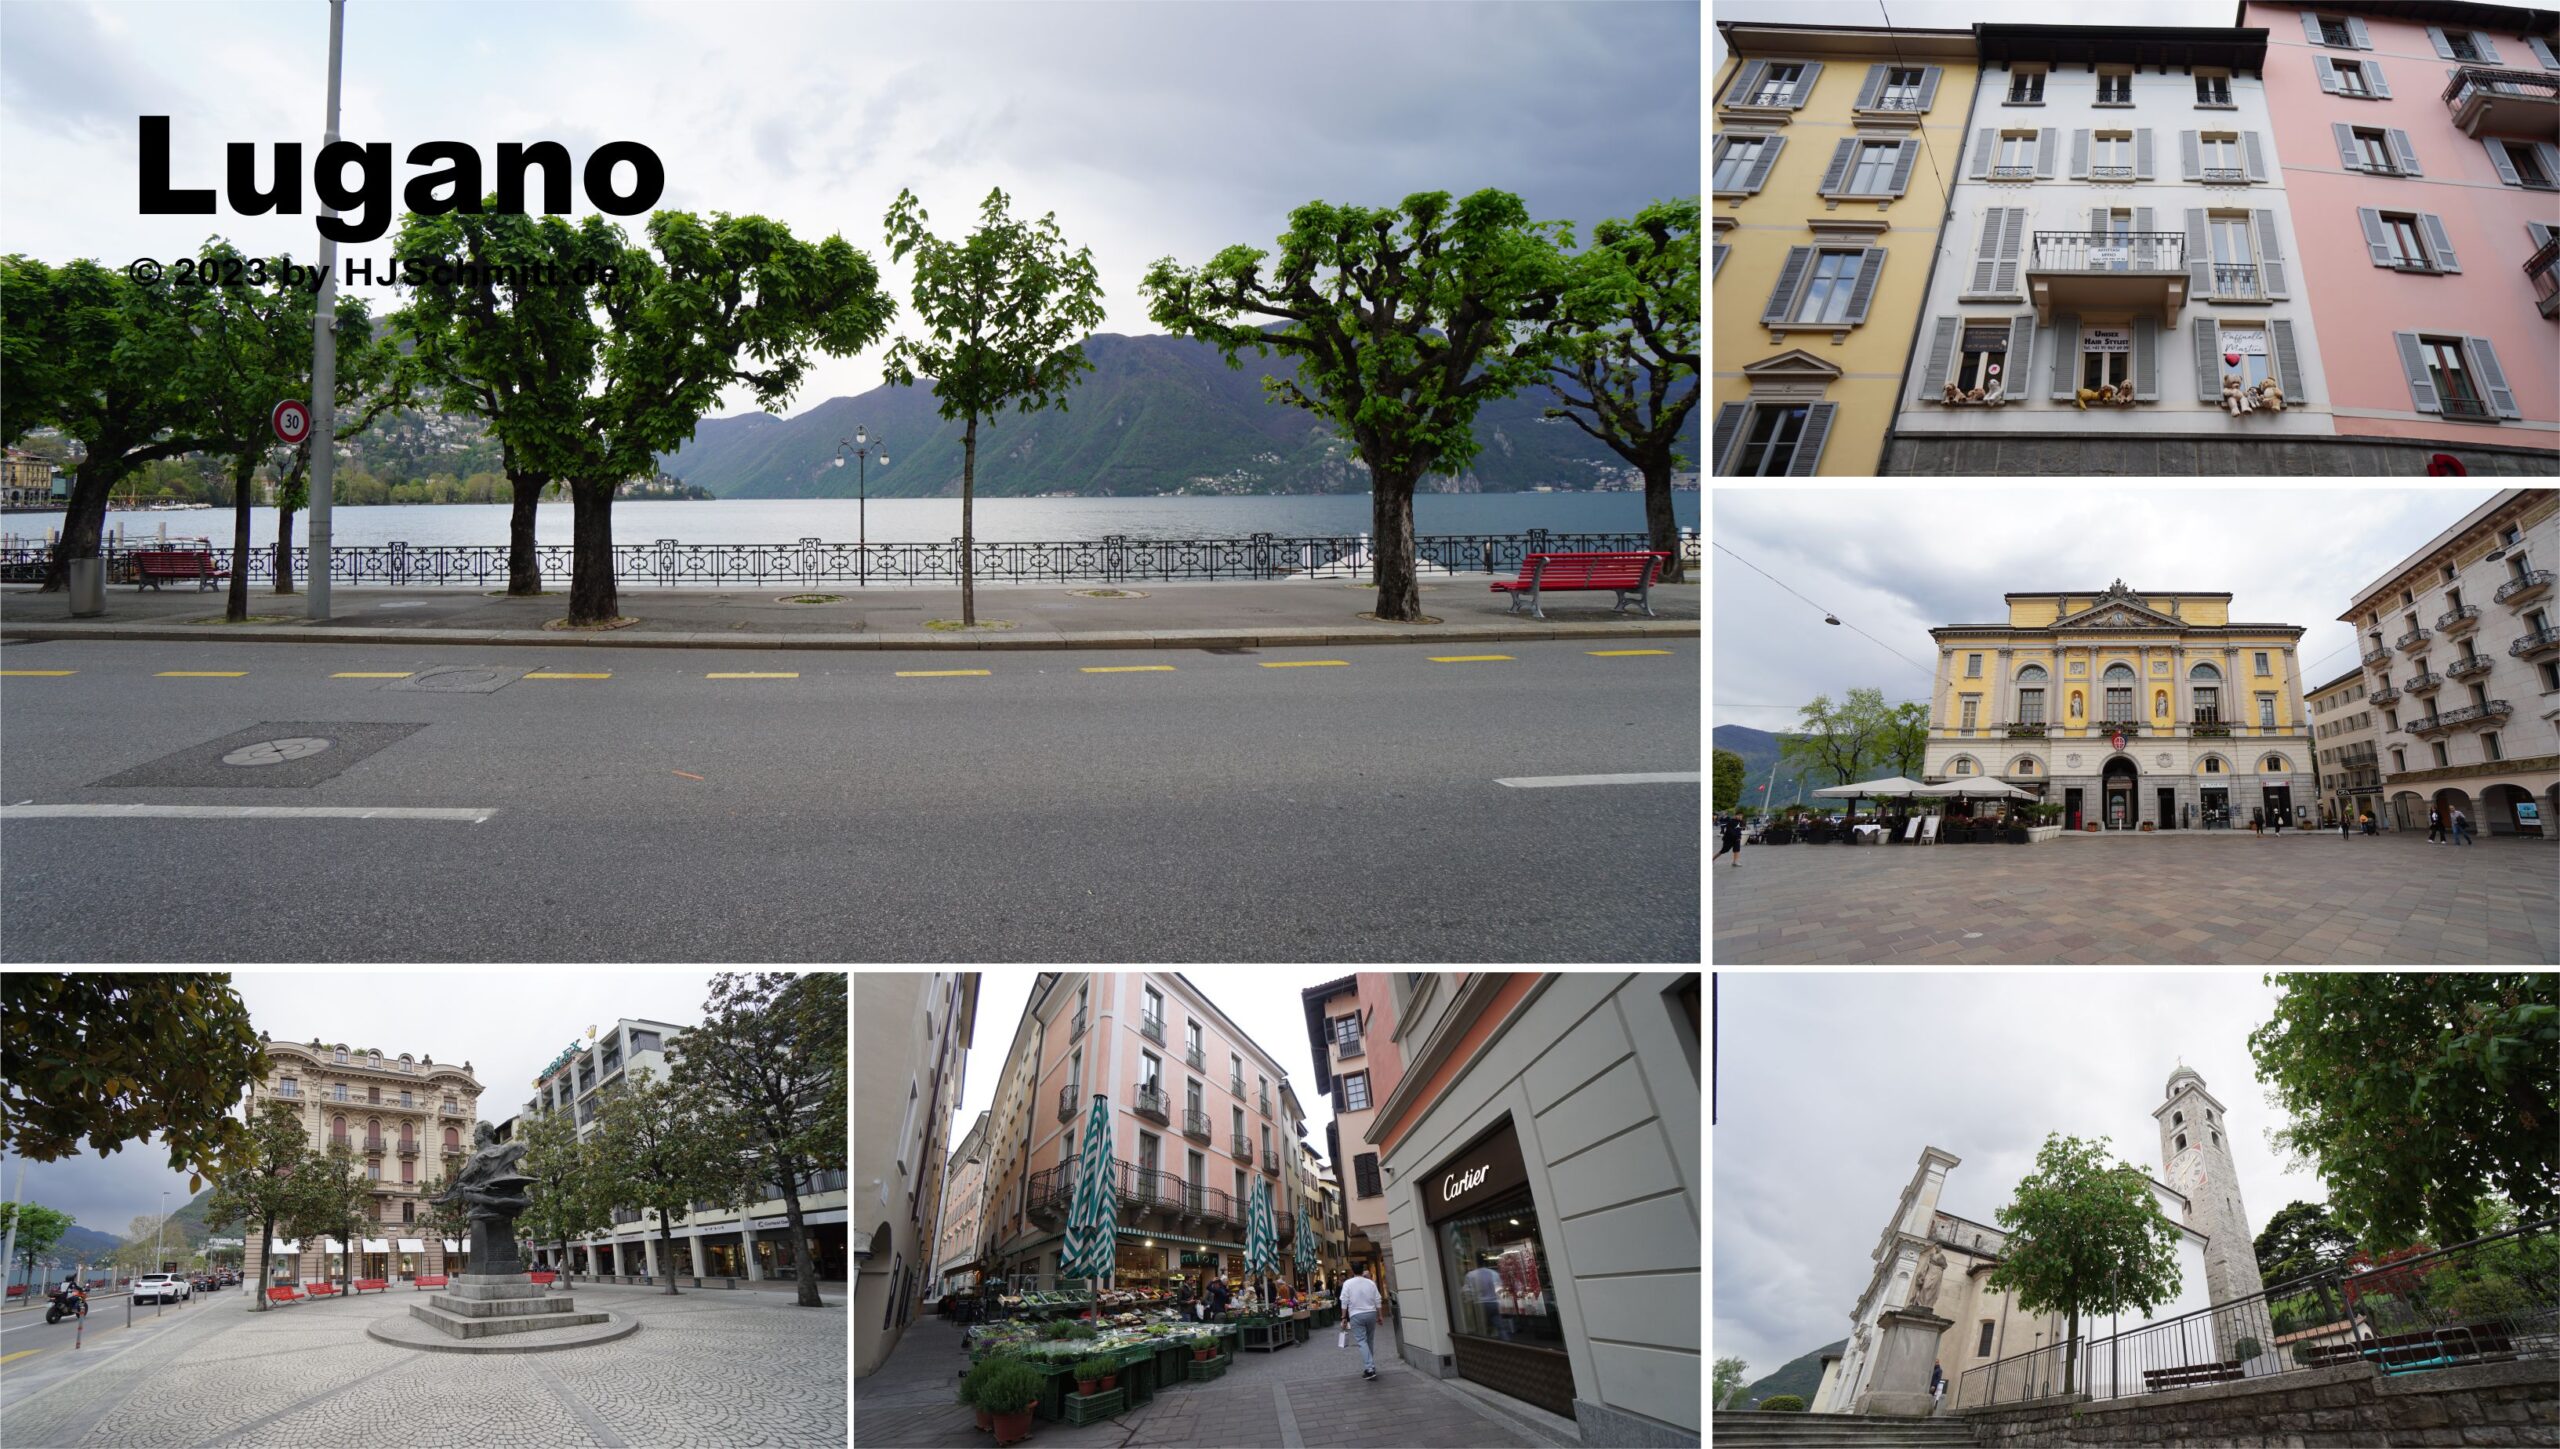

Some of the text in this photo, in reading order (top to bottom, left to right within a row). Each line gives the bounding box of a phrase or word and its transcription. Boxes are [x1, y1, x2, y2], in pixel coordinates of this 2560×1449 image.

[285, 414, 299, 429] 30
[539, 1038, 582, 1079] ROLEX
[1443, 1164, 1490, 1202] Cartier
